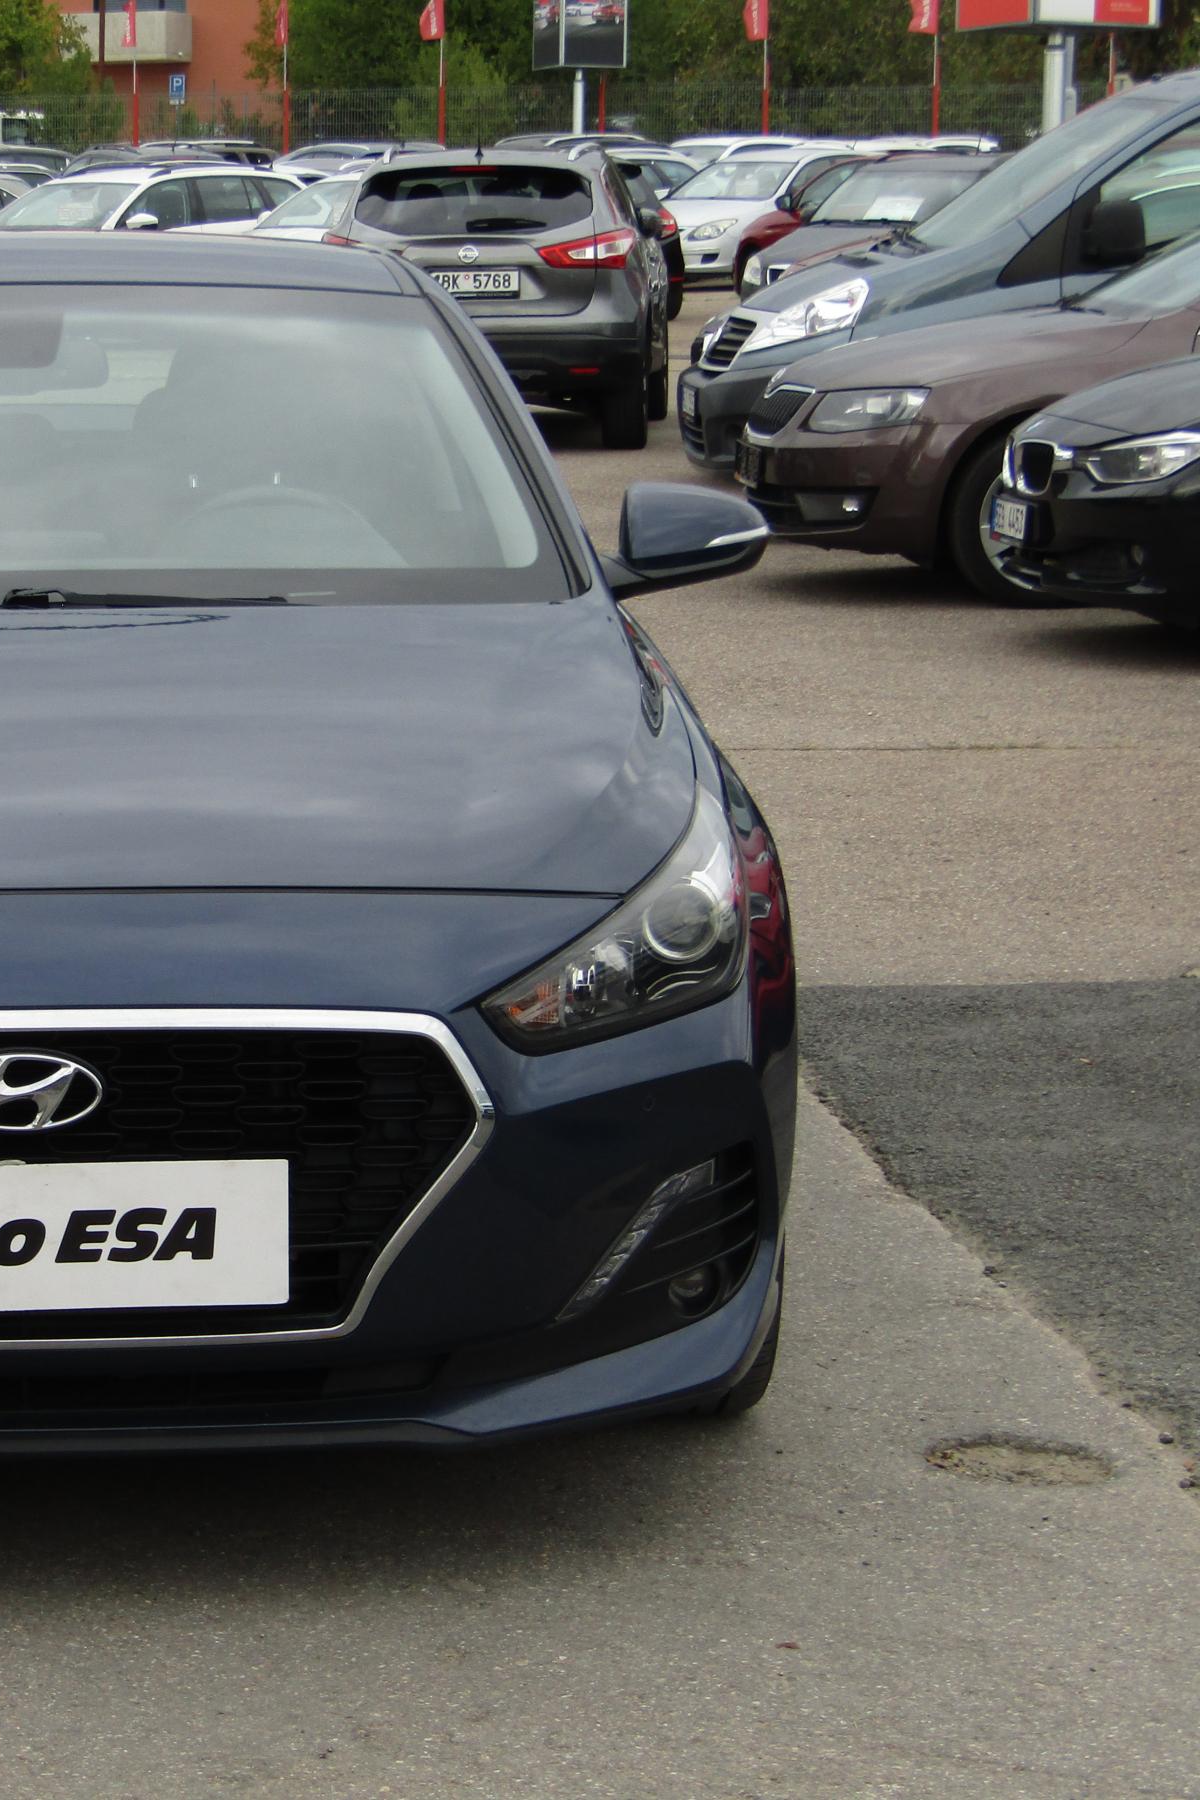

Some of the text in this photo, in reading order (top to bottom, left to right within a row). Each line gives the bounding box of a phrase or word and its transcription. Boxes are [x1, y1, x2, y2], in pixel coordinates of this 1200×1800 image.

[173, 77, 182, 91] P
[473, 273, 511, 289] 5768
[55, 1207, 217, 1264] ESA
